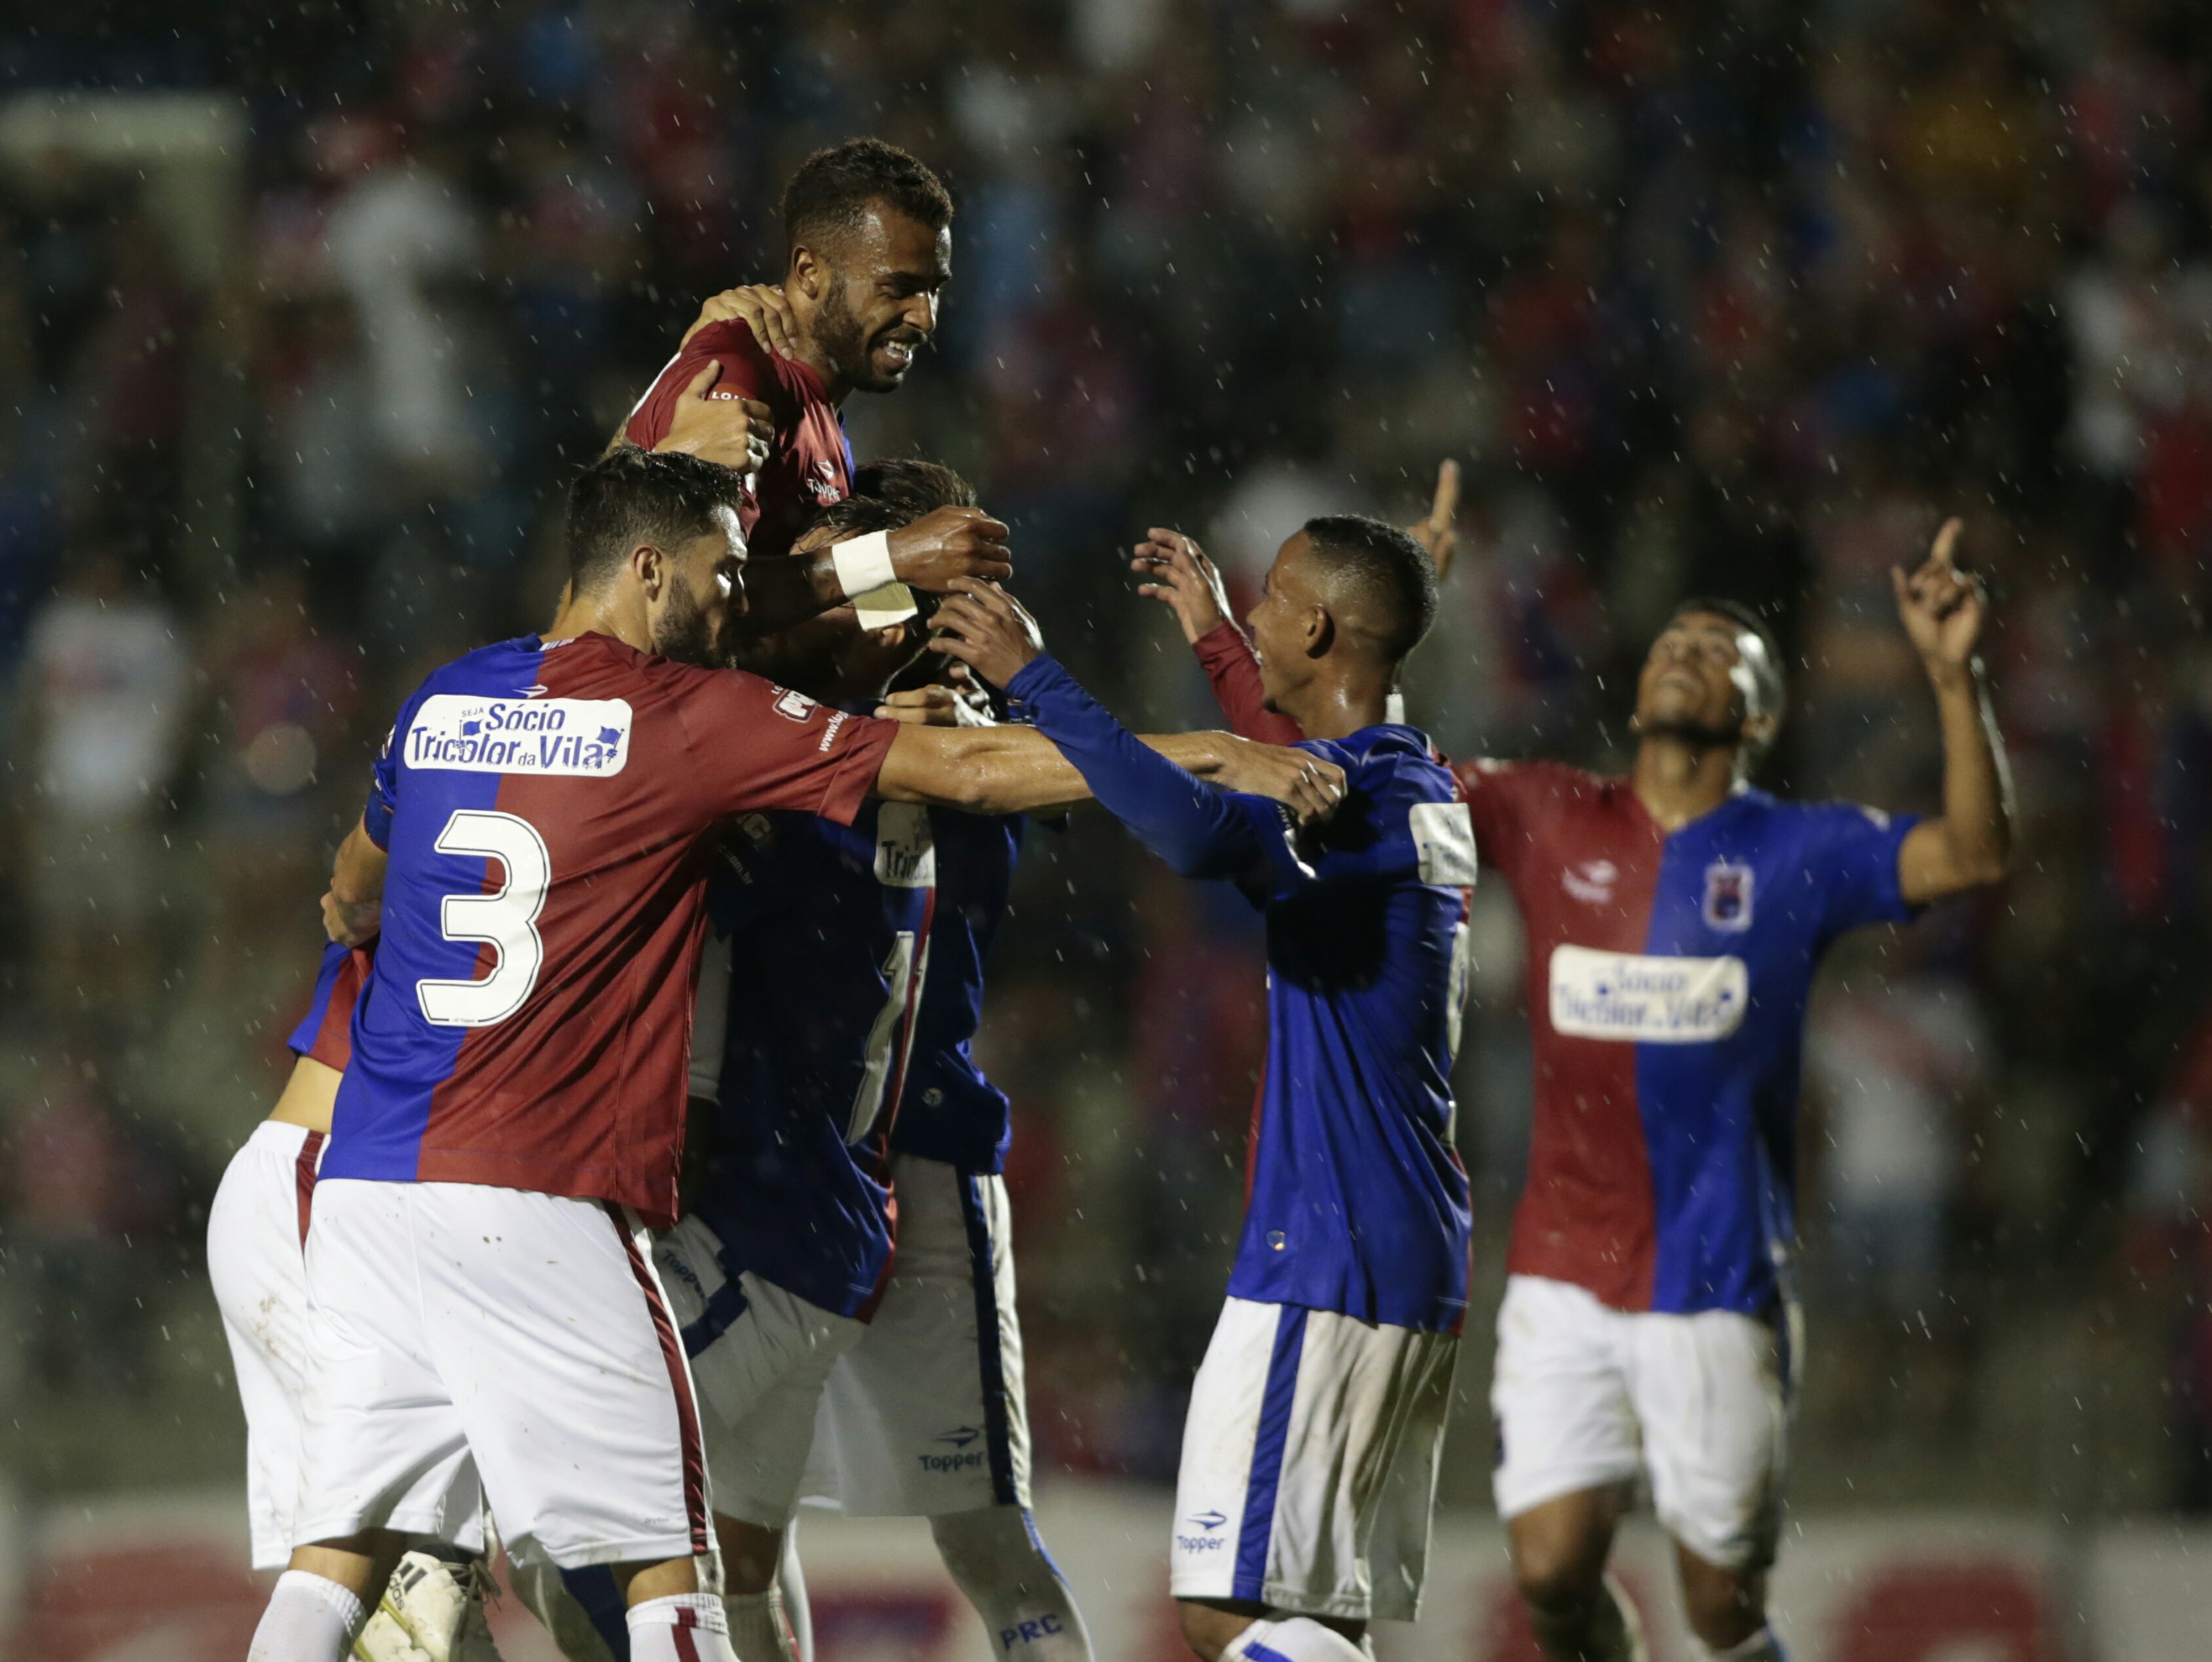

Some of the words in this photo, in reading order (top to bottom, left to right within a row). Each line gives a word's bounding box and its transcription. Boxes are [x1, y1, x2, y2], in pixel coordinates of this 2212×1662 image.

[711, 391, 747, 401] LO
[771, 685, 784, 695] LO
[779, 690, 817, 718] PR
[461, 707, 485, 718] SEJA
[485, 703, 566, 731] Sócio
[411, 726, 521, 766] Tricolor
[517, 752, 536, 766] da
[540, 735, 604, 770] Vila
[416, 809, 551, 1027] 3
[918, 1450, 984, 1473] Topper
[1176, 1535, 1226, 1554] Topper
[999, 1613, 1064, 1651] PRC
